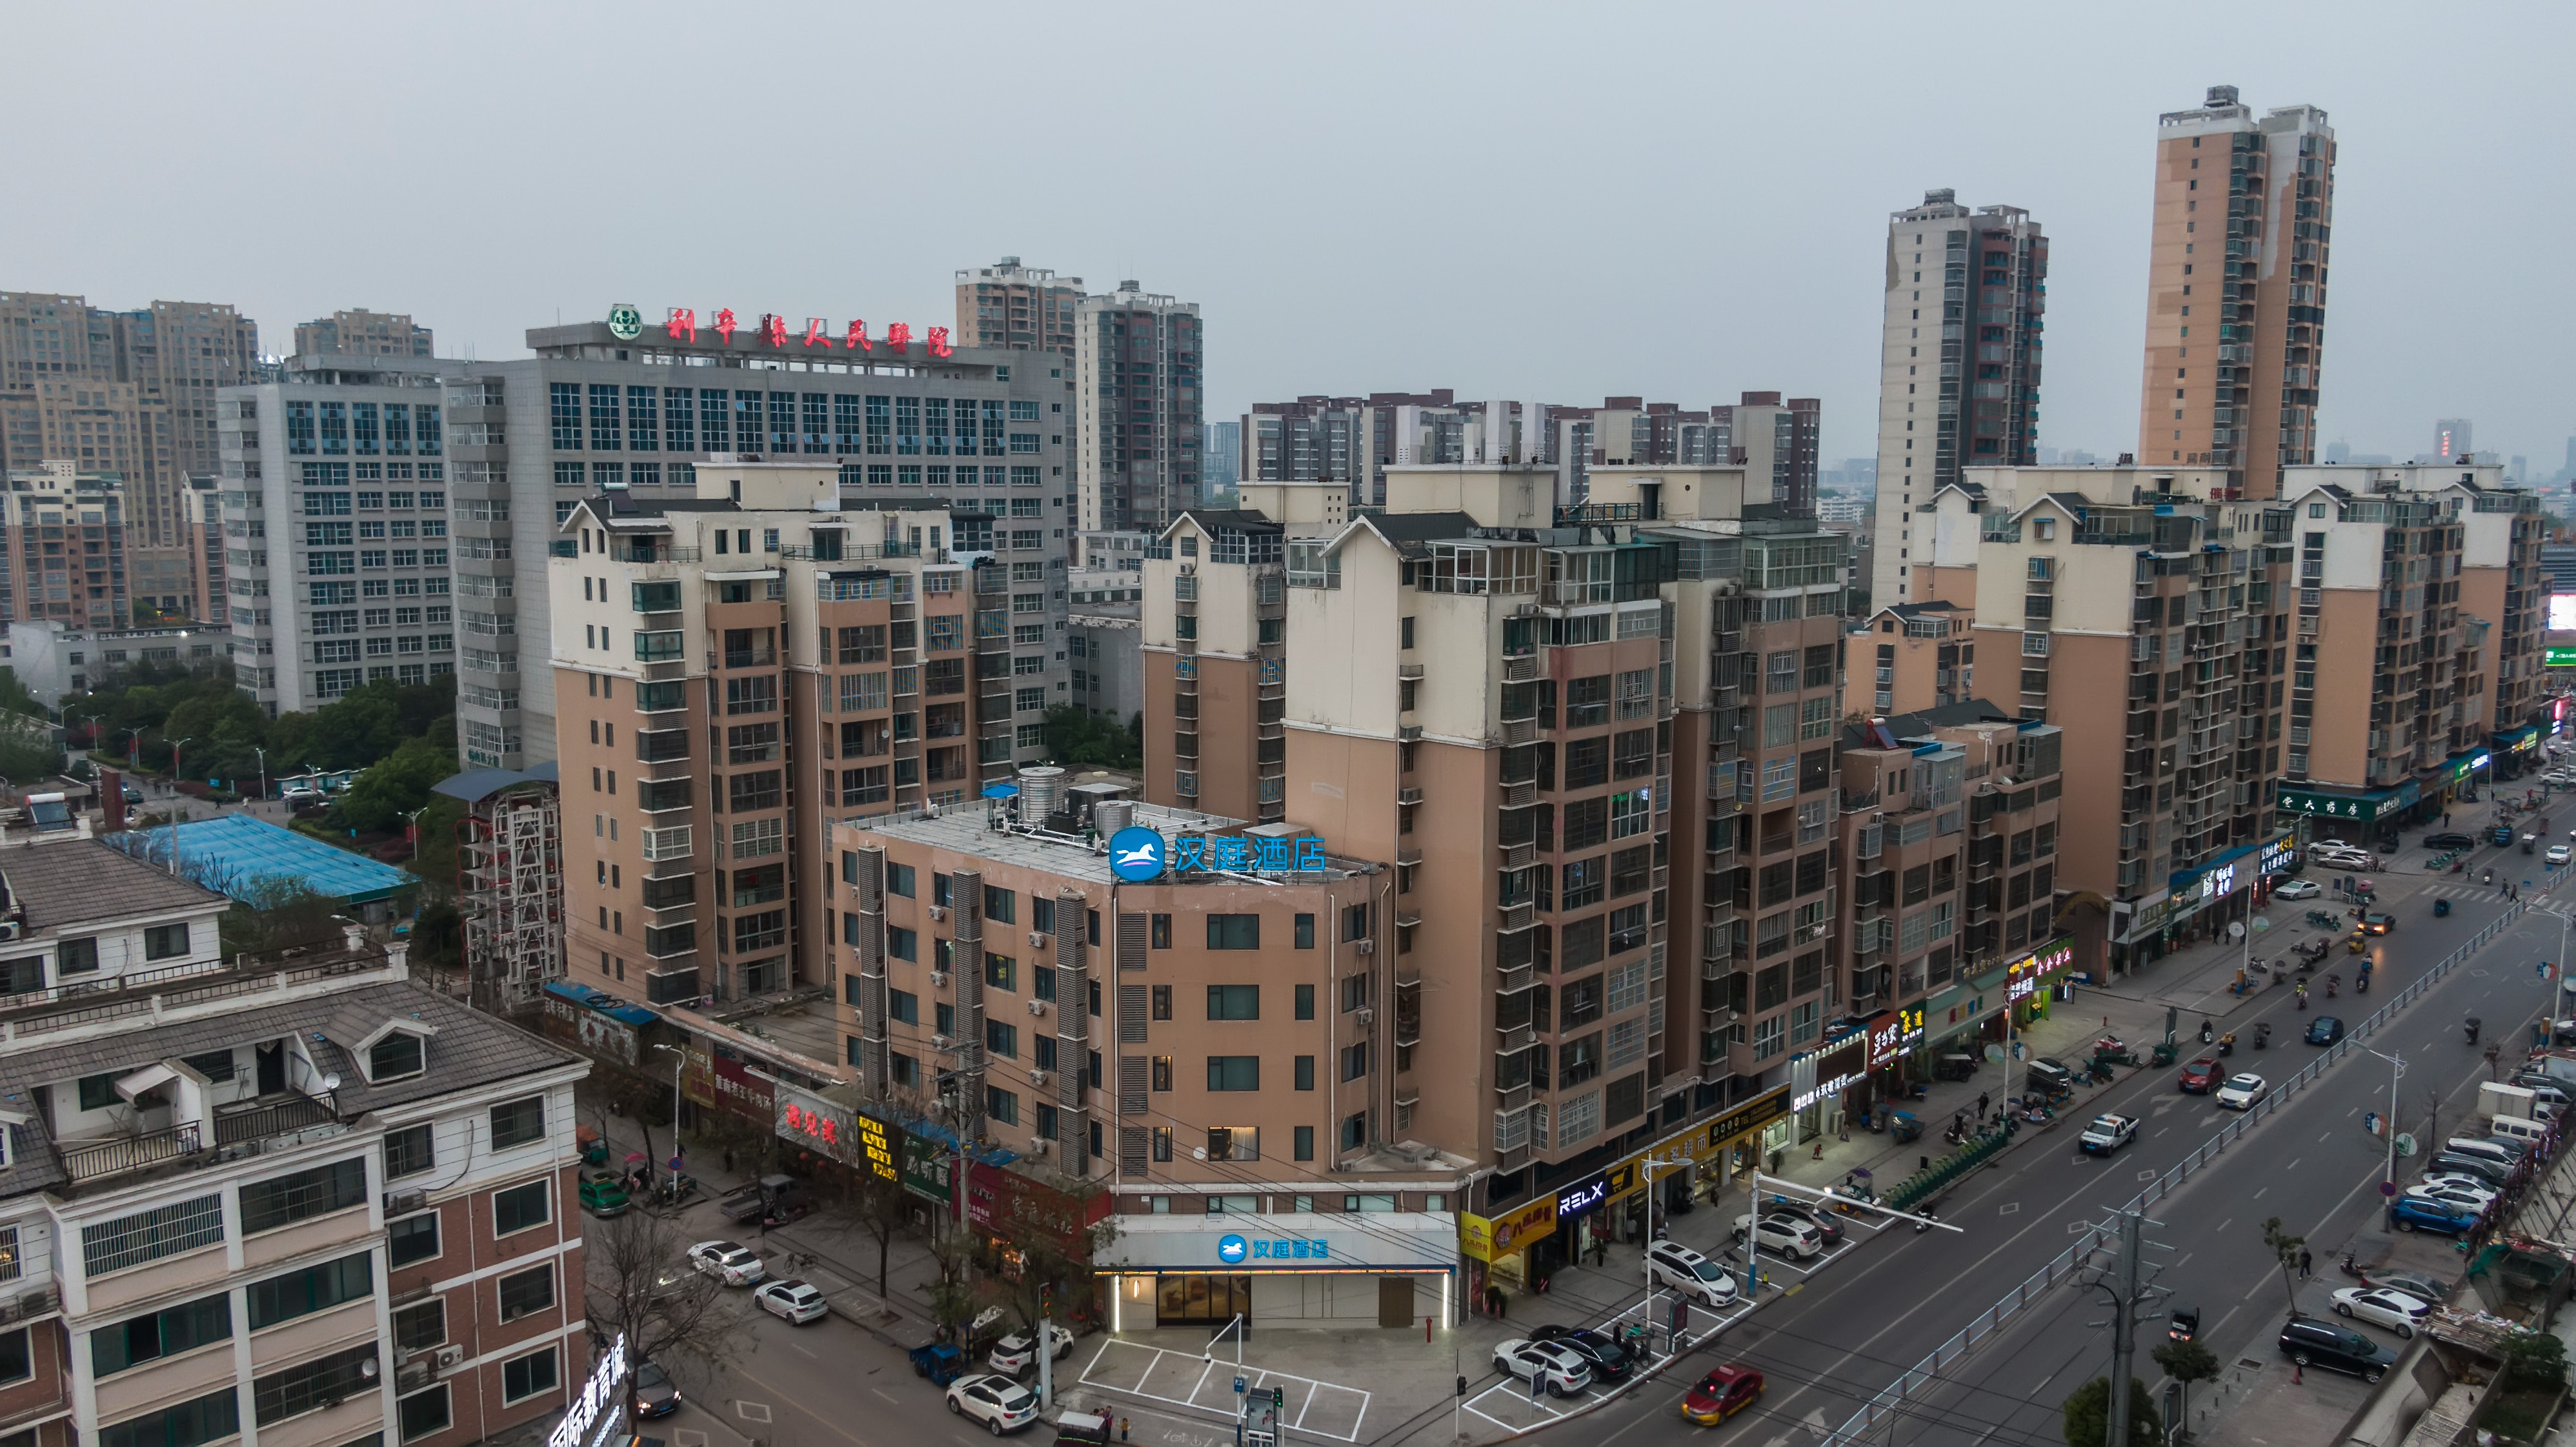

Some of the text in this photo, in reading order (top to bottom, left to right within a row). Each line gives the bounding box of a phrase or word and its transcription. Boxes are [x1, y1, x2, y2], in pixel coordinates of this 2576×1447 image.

[1175, 836, 1325, 871] 汉庭酒店
[1559, 1181, 1604, 1215] RELX
[1253, 1239, 1328, 1259] 汉庭酒店
